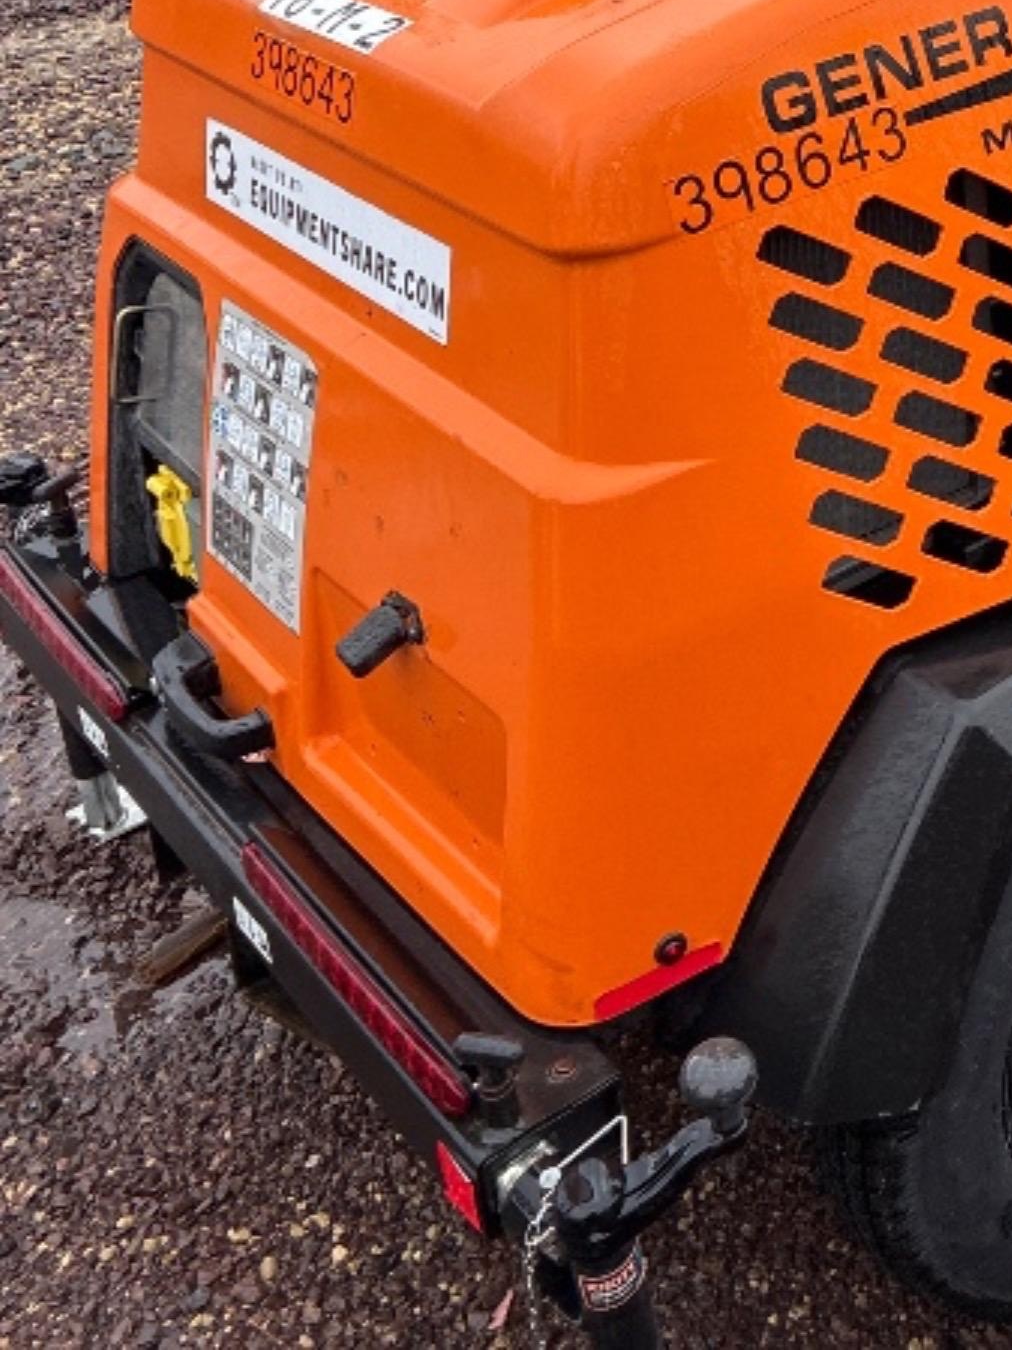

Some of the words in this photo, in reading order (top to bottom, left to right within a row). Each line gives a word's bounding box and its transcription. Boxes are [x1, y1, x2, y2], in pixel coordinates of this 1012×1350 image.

[250, 30, 356, 124] 398643
[673, 106, 908, 235] 398643
[250, 178, 446, 323] EQUIPMENTSHARE.COM
